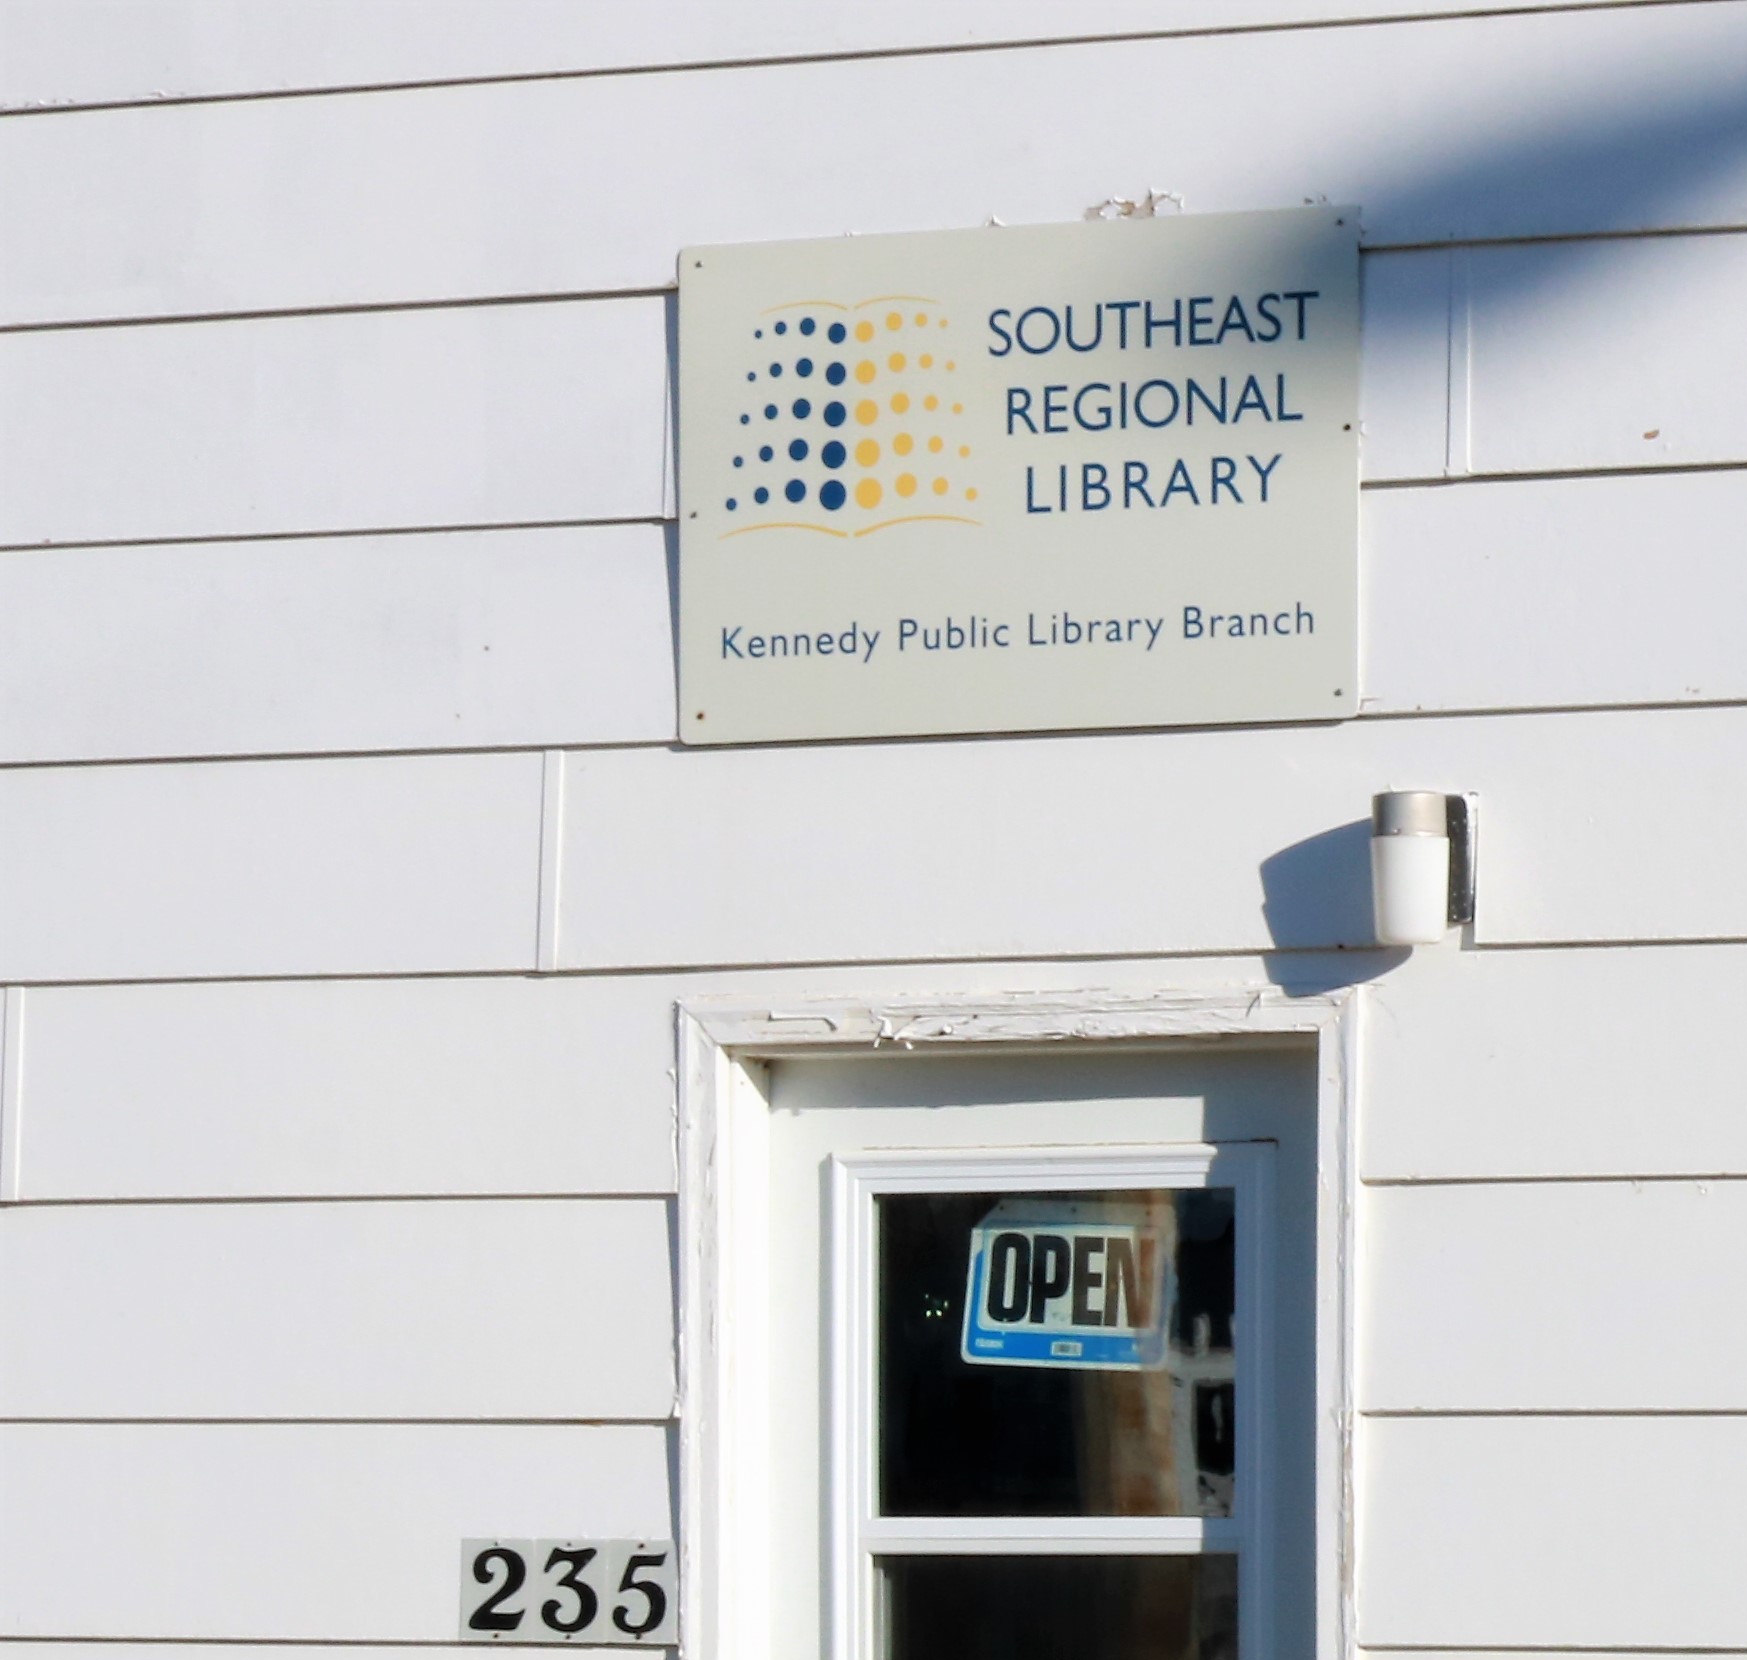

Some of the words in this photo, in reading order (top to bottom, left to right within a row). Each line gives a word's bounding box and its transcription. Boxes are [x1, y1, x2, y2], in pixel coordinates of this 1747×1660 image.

[988, 291, 1320, 358] SOUTHEAST
[1005, 373, 1303, 436] REGIONAL
[1026, 454, 1283, 514] LIBRARY
[721, 625, 881, 663] Kennedy
[898, 616, 1010, 652] Public
[1028, 611, 1164, 650] Library
[1182, 601, 1316, 640] Branch
[986, 1232, 1155, 1329] OPEN
[468, 1547, 668, 1635] 235
